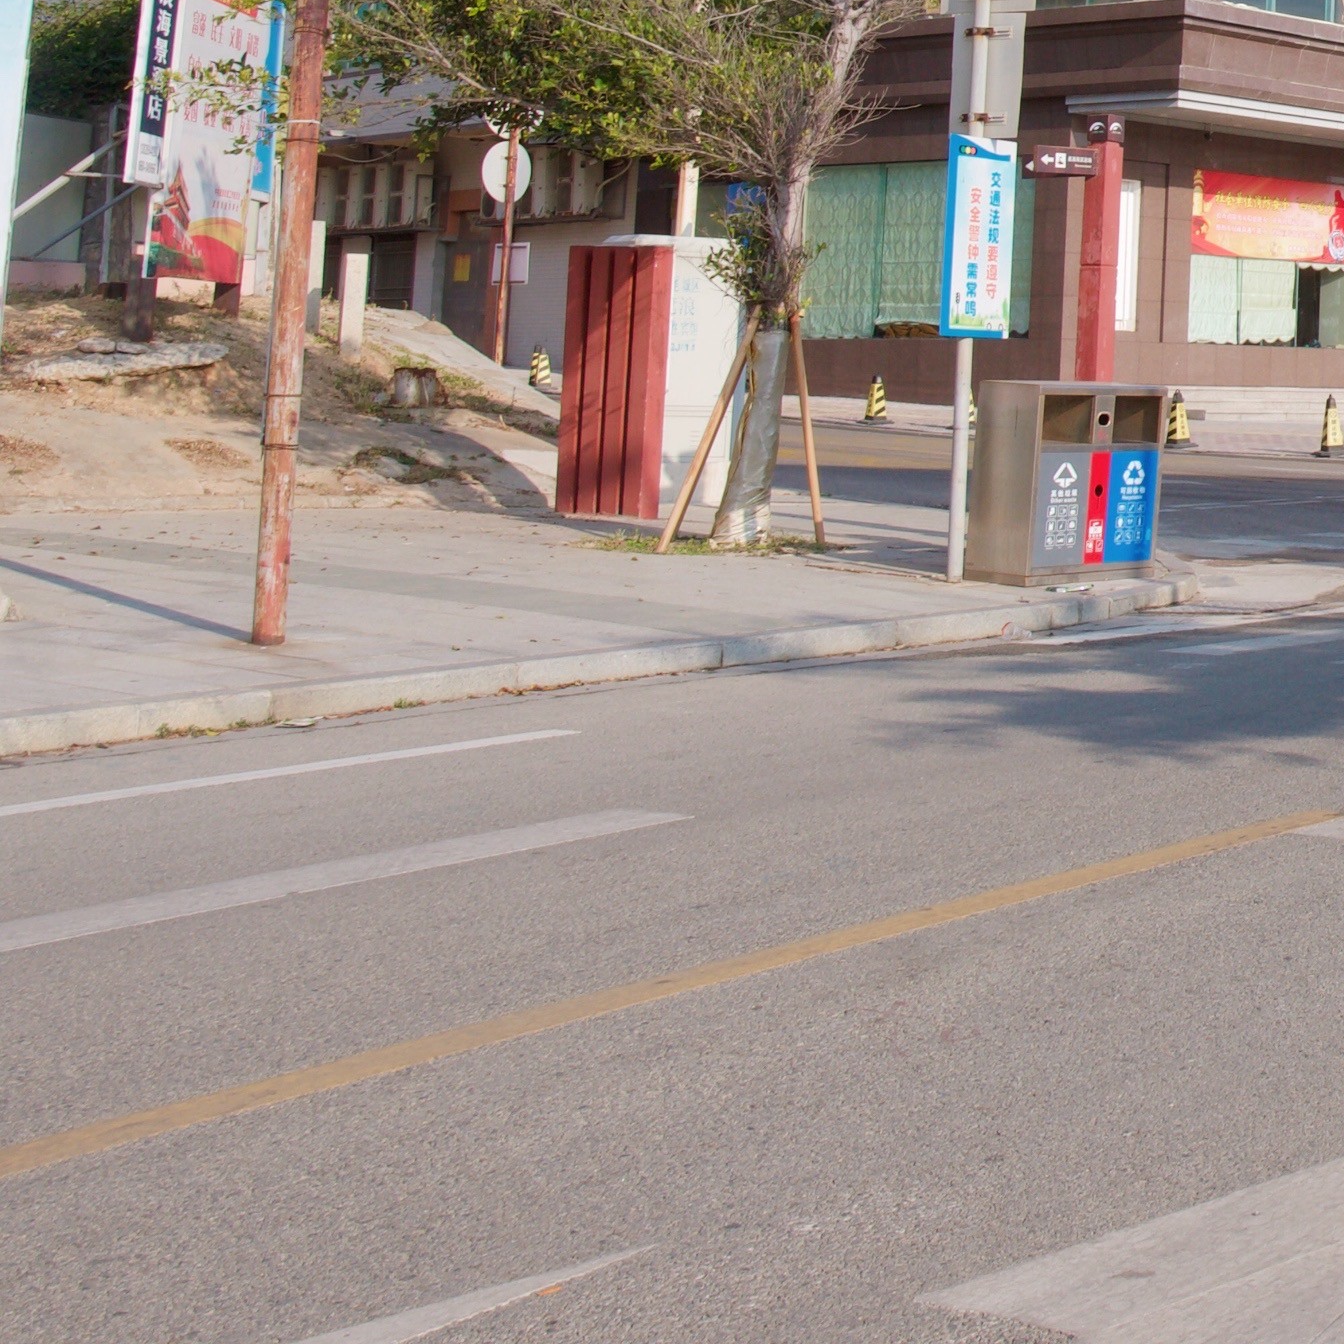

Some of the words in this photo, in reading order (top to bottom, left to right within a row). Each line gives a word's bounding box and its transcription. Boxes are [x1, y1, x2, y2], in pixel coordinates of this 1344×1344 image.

[964, 187, 982, 317] 安全警钟需常鸣
[985, 172, 1002, 300] 交通法规要遵守
